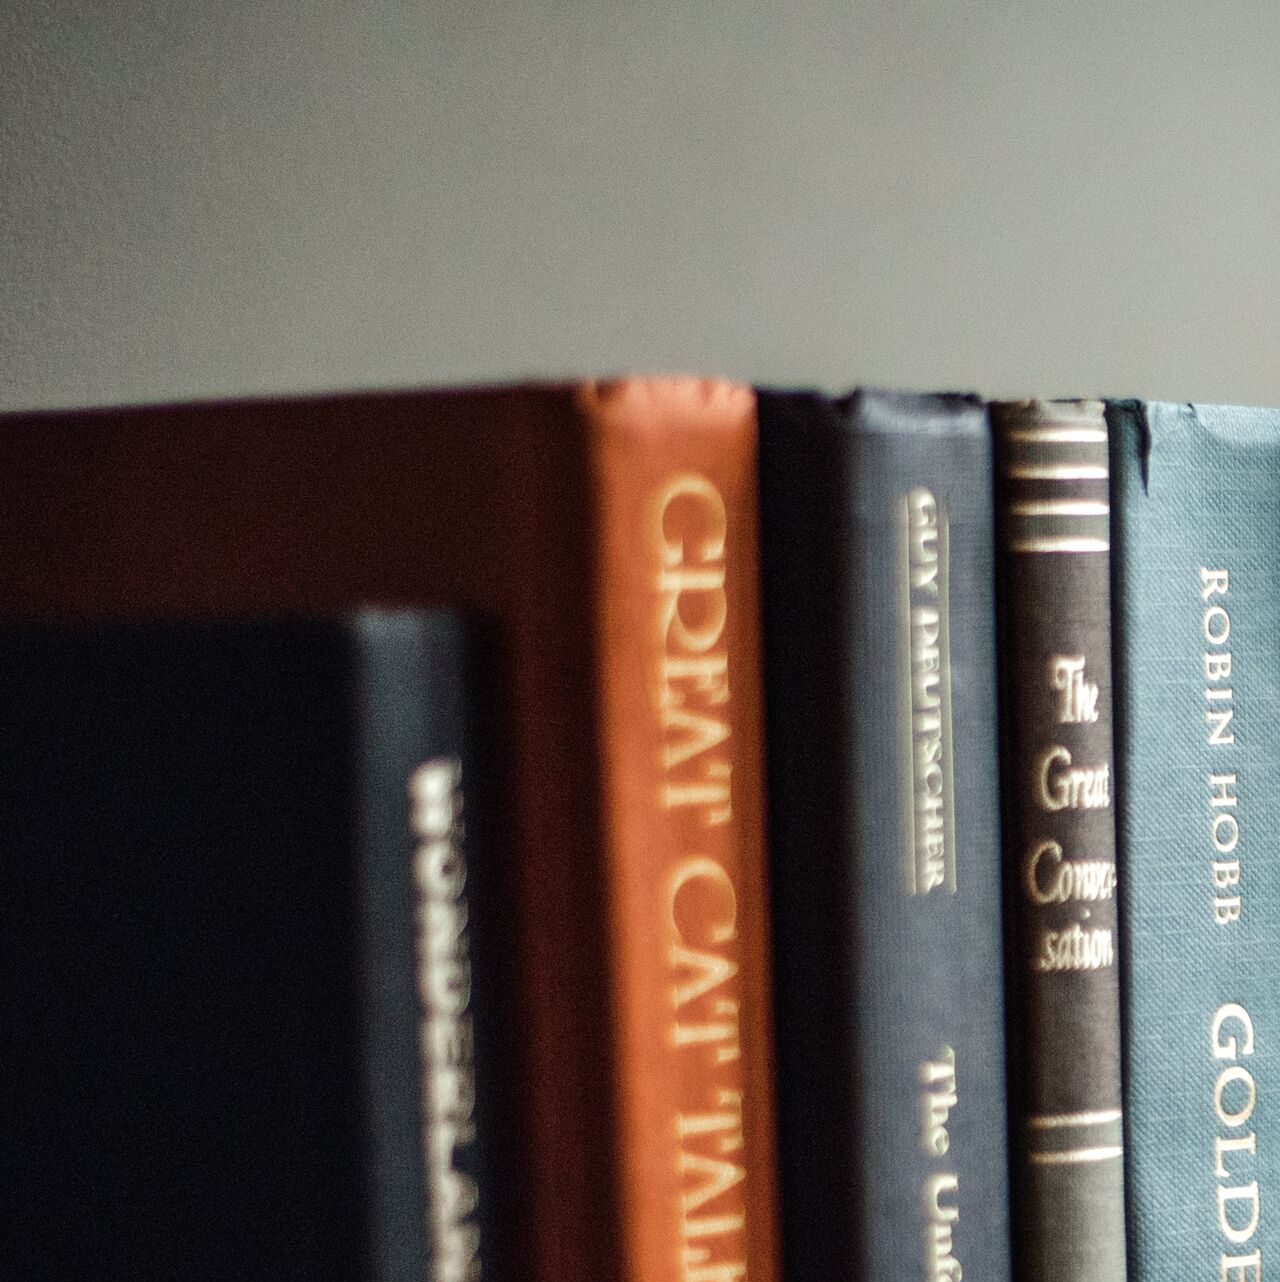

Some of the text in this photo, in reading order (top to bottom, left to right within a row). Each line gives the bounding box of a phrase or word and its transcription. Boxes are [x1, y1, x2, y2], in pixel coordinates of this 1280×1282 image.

[654, 474, 732, 824] GREAT
[908, 490, 946, 892] GUY DEUTSCHER
[1054, 656, 1099, 724] The
[1200, 566, 1241, 925] ROBIN HOBB
[1041, 746, 1109, 811] Great
[664, 858, 741, 1062] CAT
[919, 1047, 959, 1156] The
